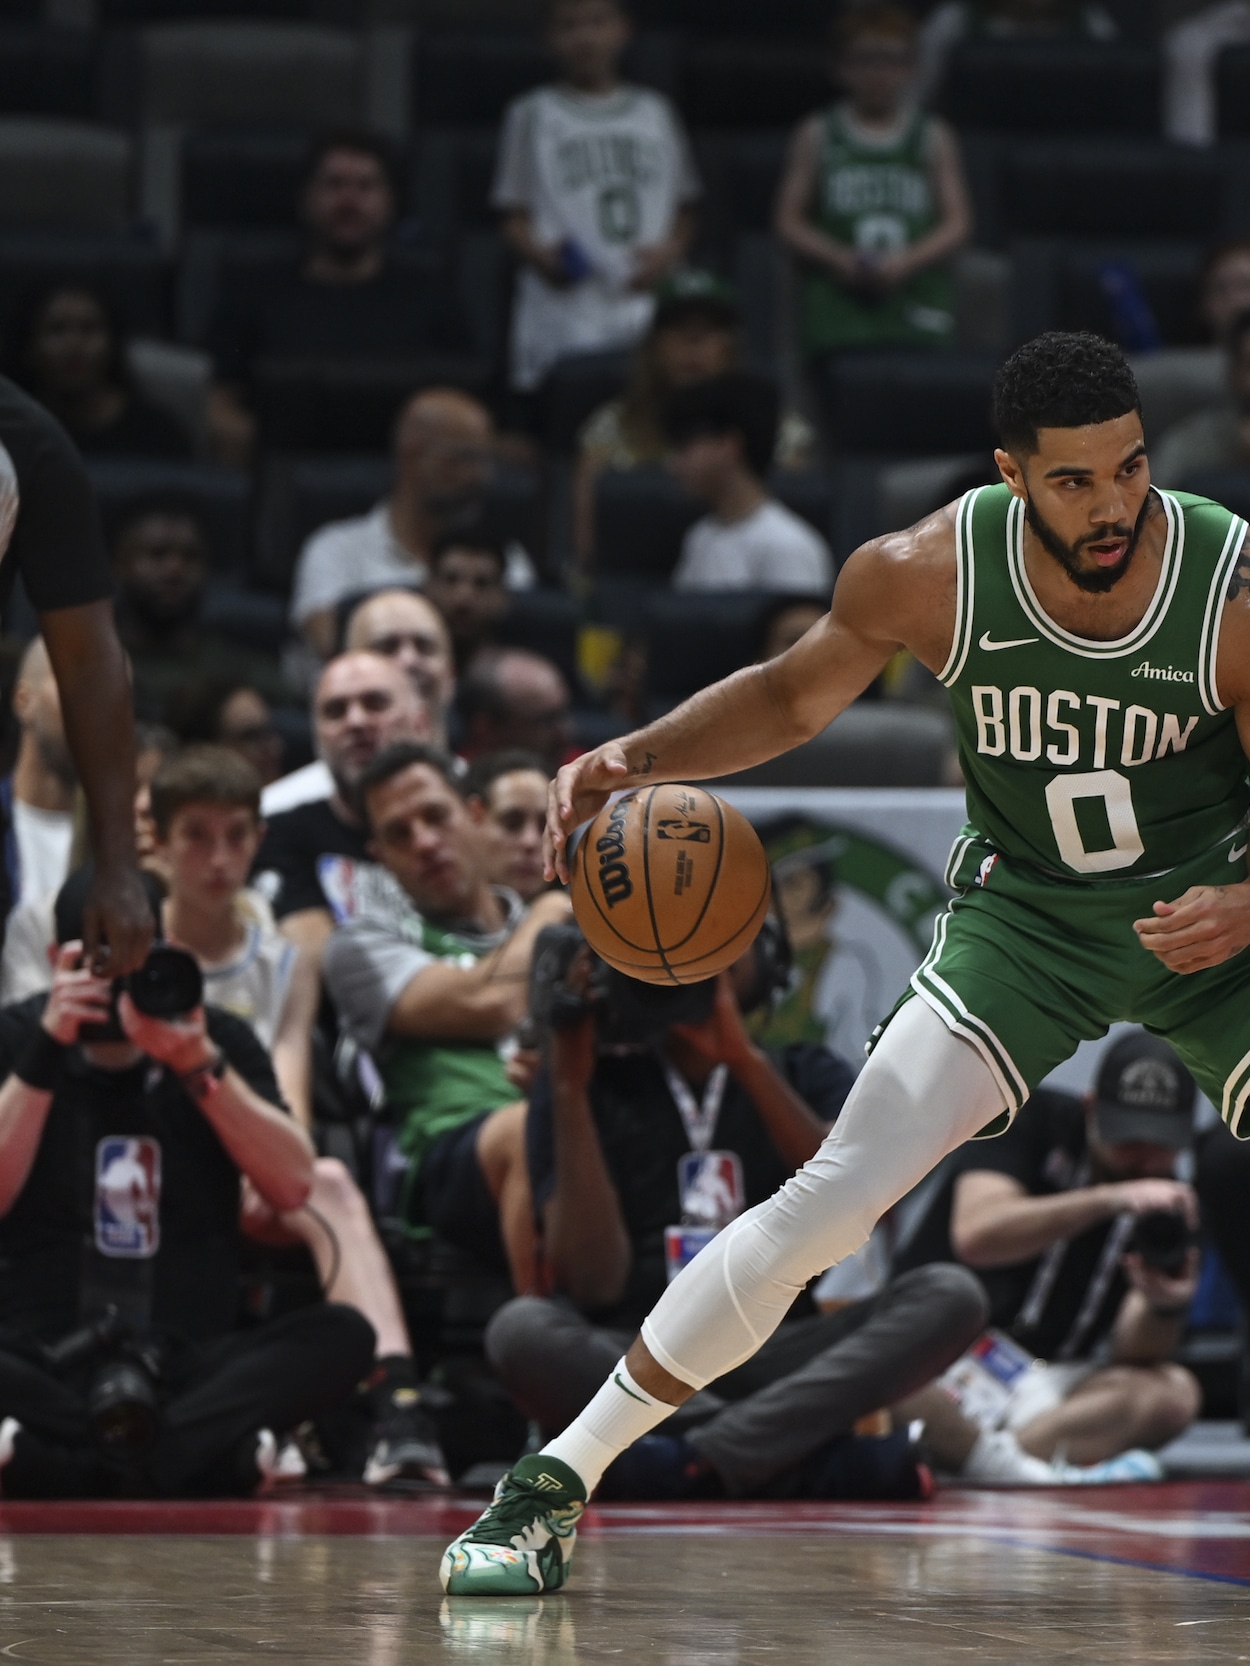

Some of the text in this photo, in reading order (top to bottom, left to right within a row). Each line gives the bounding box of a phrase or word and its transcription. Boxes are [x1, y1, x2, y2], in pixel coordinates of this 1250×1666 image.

[1130, 660, 1196, 684] Amica
[970, 684, 1200, 769] BOSTON
[1044, 768, 1146, 874] 0
